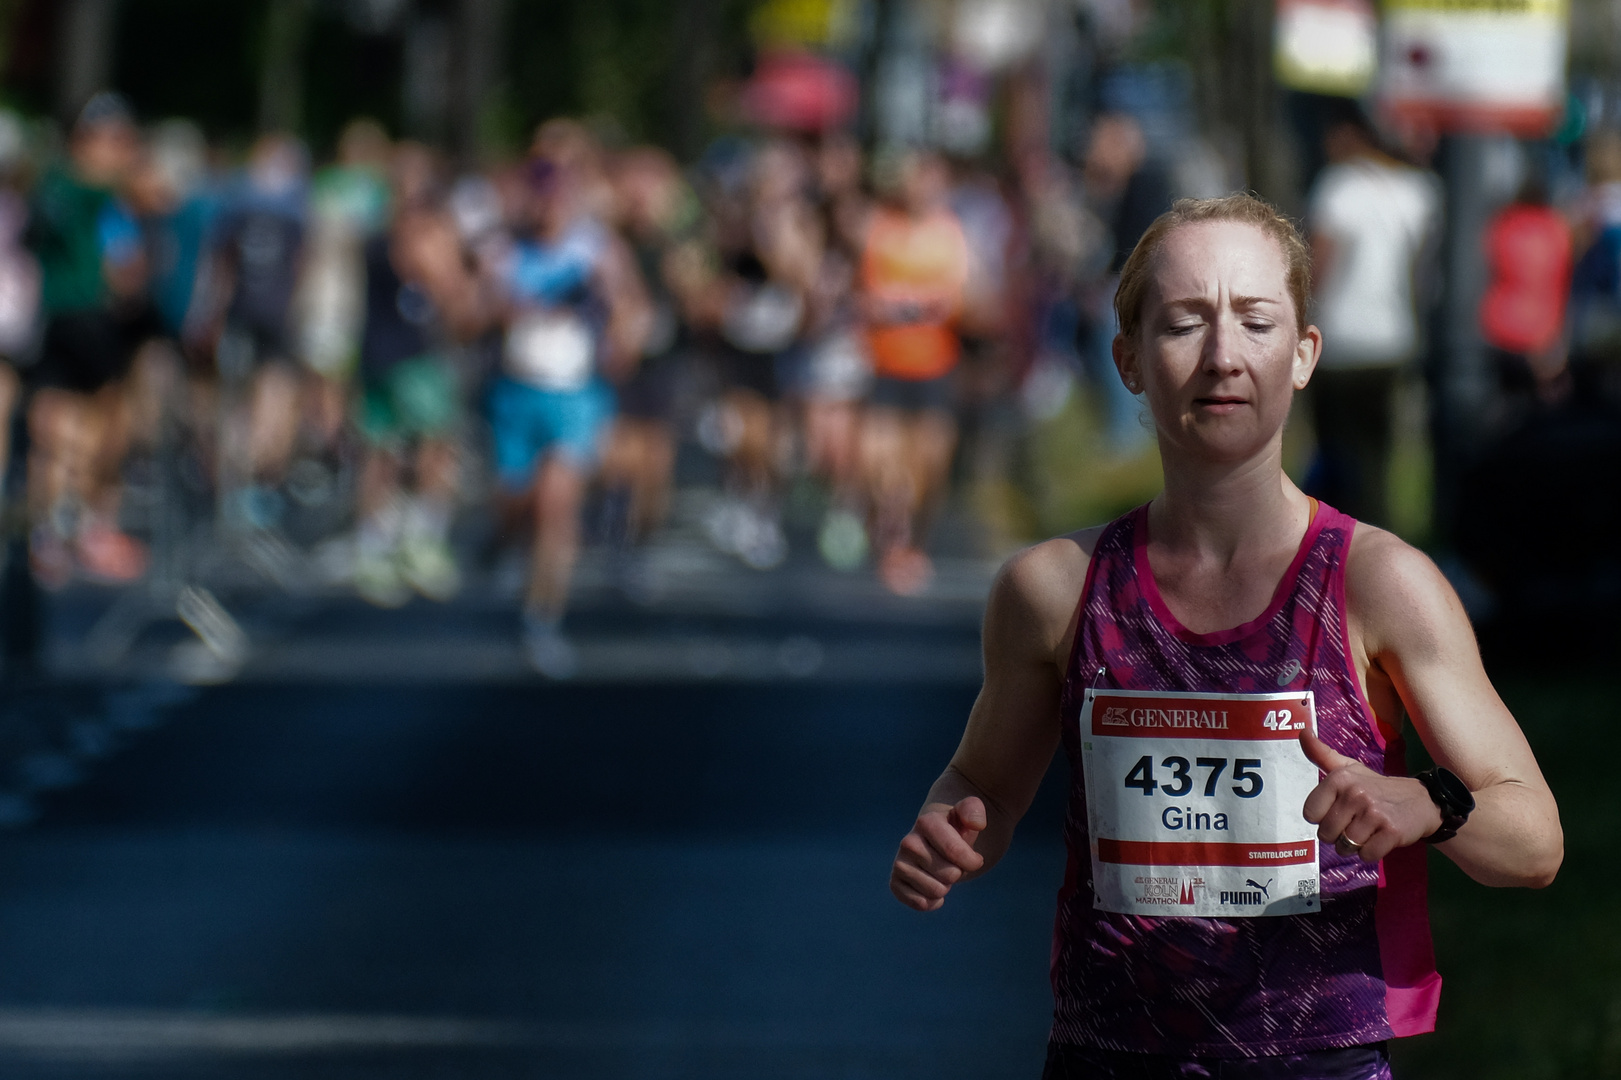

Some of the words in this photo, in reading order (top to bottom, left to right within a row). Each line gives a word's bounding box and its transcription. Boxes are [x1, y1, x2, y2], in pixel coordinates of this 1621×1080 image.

[1130, 709, 1229, 730] GENERALI
[1263, 709, 1292, 731] 42
[1124, 754, 1264, 799] 4375
[1161, 806, 1229, 831] Gina
[1248, 850, 1293, 859] STARTBLOCK
[1294, 848, 1308, 857] ROT
[1144, 877, 1178, 885] GENERALI
[1135, 897, 1178, 905] MARATHON
[1220, 891, 1262, 905] PUMA
